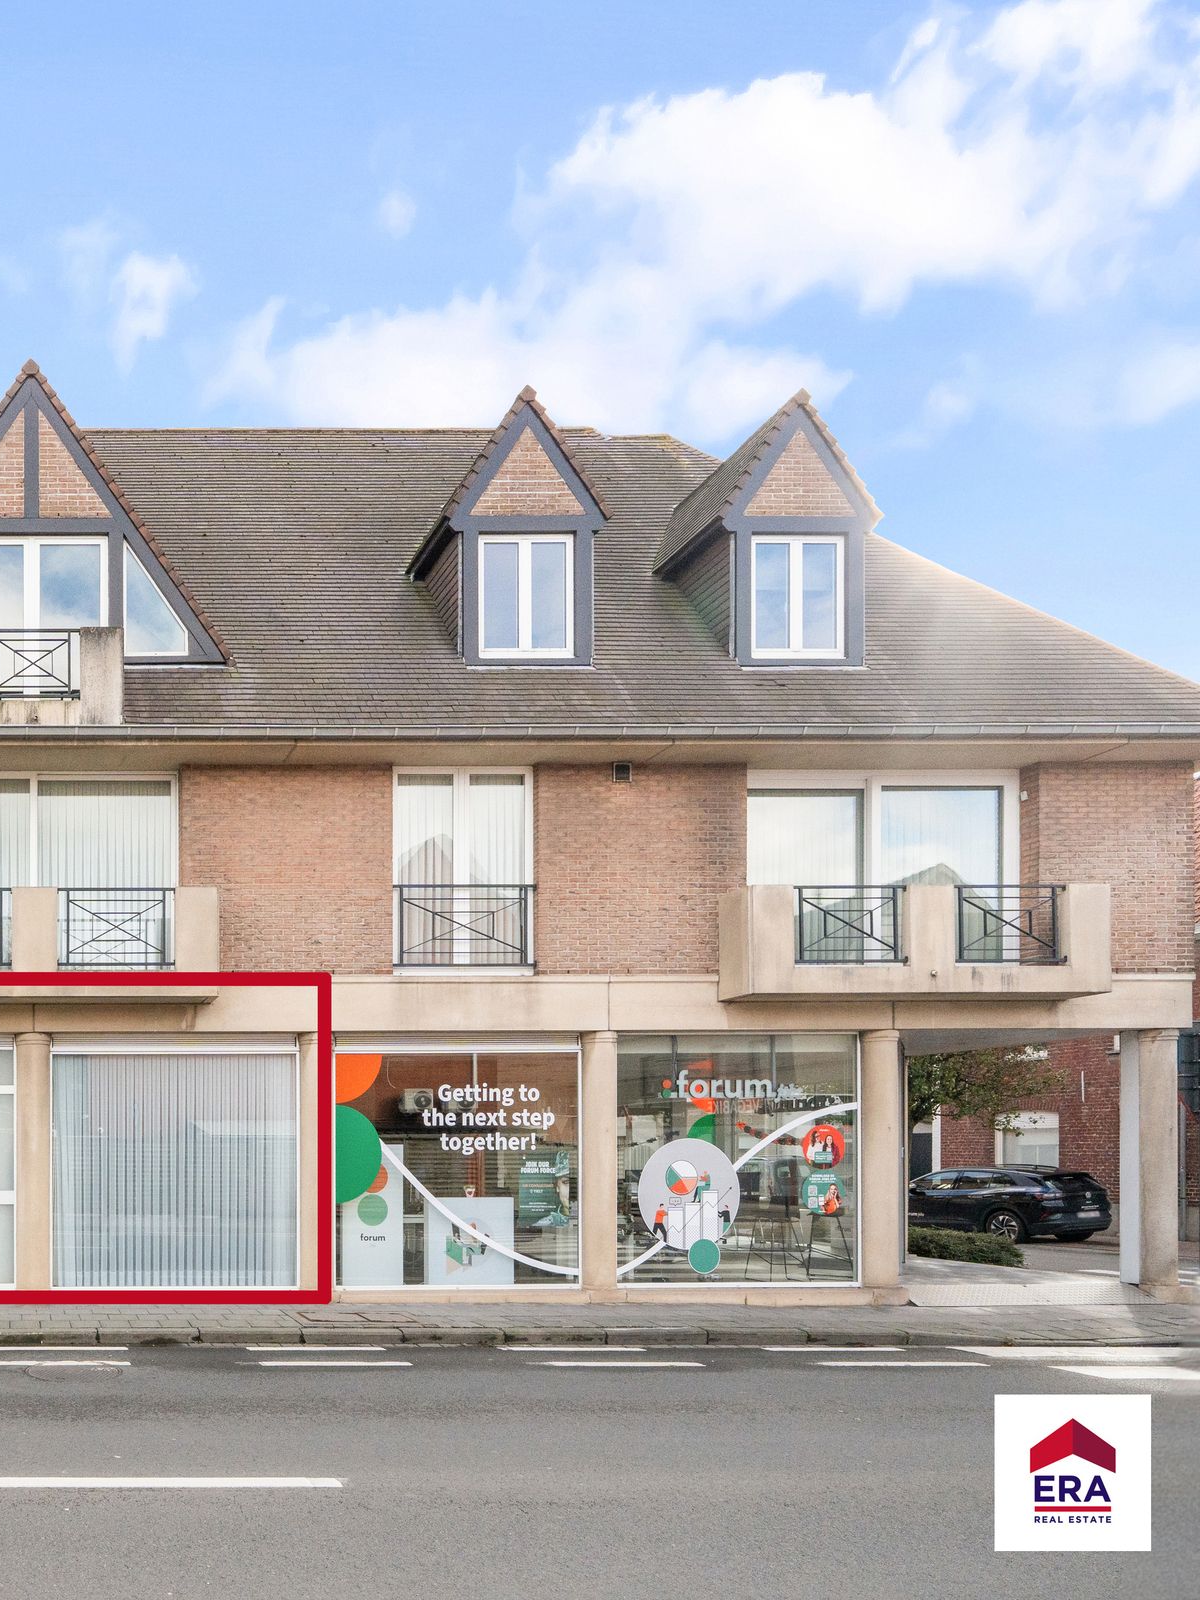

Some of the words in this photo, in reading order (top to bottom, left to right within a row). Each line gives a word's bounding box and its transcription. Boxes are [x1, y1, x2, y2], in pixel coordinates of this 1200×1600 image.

[438, 1083, 515, 1107] Getting
[519, 1084, 541, 1103] to
[676, 1069, 776, 1099] forum
[422, 1108, 457, 1127] the
[462, 1109, 507, 1127] next
[511, 1109, 556, 1131] step
[440, 1132, 537, 1156] together!
[360, 1232, 386, 1242] forum
